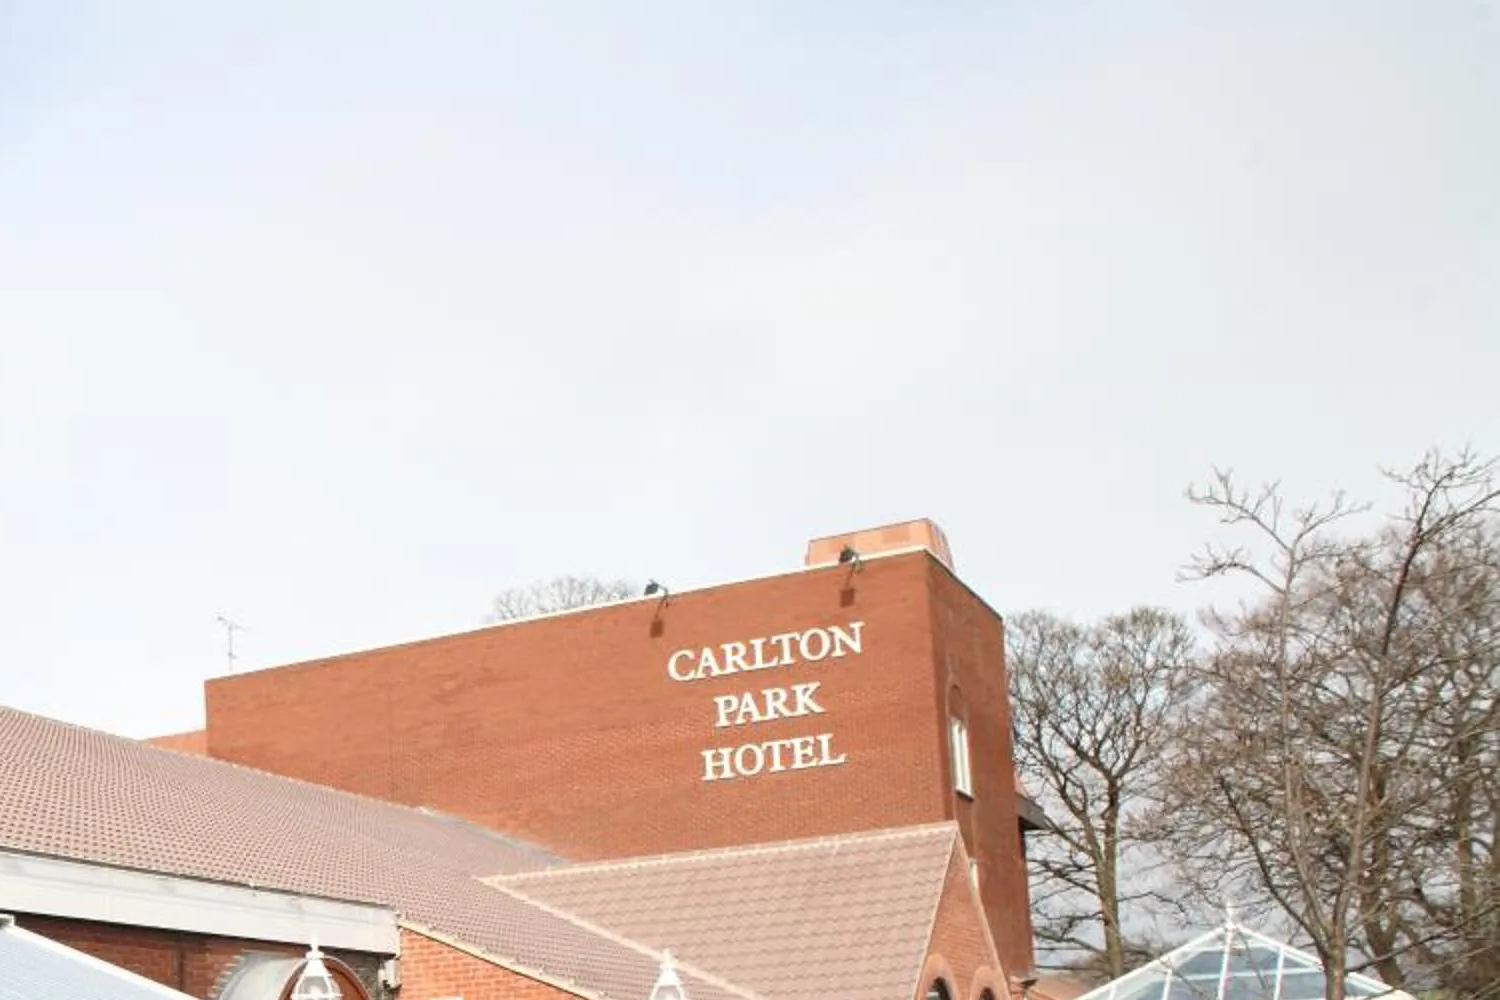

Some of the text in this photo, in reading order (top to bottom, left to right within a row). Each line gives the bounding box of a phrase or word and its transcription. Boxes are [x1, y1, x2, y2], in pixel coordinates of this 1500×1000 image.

[667, 621, 865, 681] CARLTON
[713, 682, 826, 727] PARK
[700, 733, 847, 781] HOTEL
